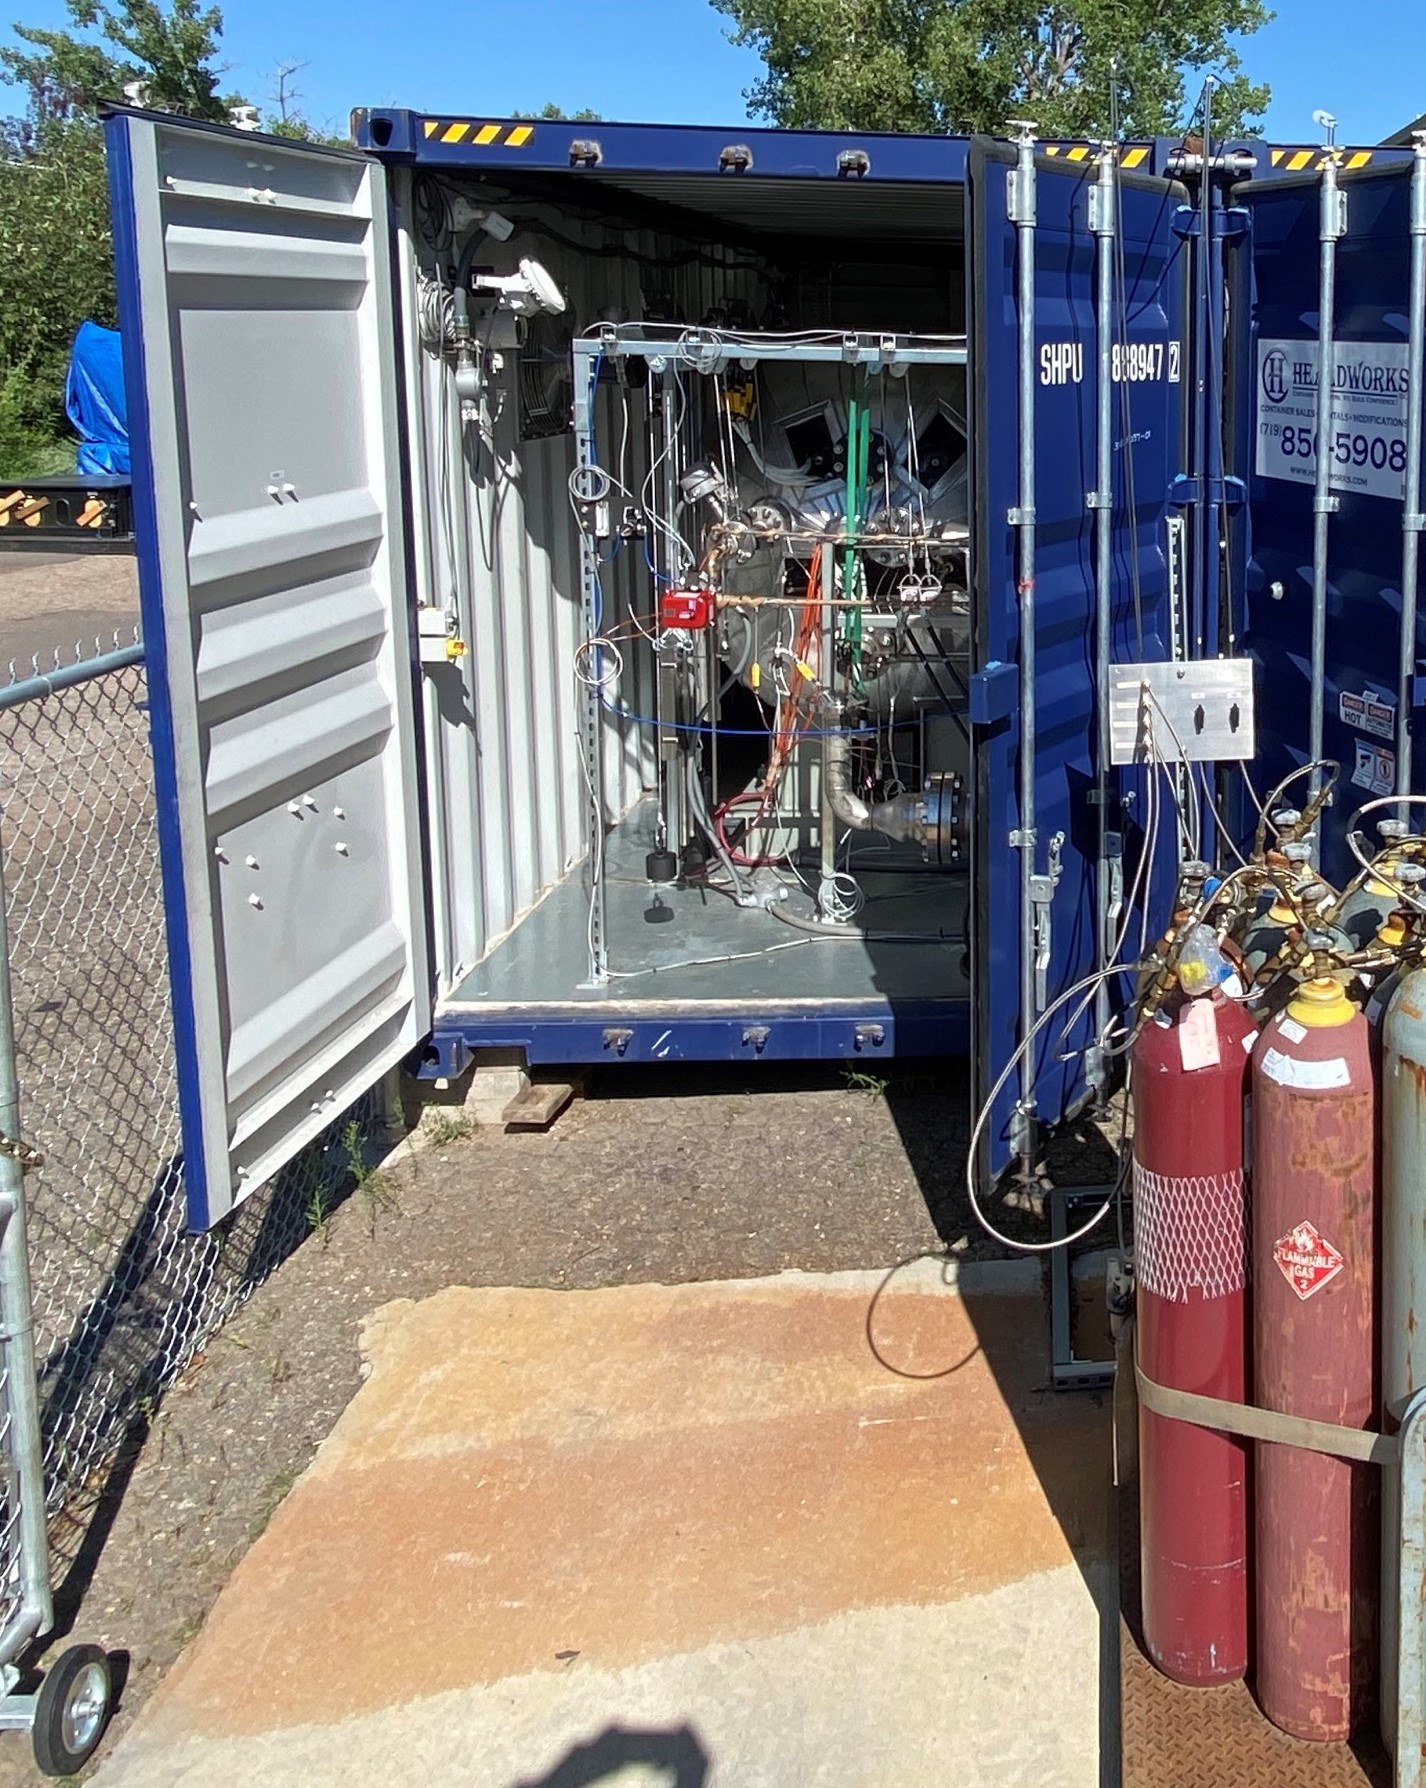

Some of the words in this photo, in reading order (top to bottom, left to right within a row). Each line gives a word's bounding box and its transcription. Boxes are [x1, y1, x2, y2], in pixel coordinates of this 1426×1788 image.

[1041, 343, 1082, 385] SHPU
[1169, 342, 1179, 381] 2
[1261, 404, 1295, 416] CONTAINER
[1295, 407, 1315, 418] SALES
[1261, 422, 1283, 437] (719)
[1344, 710, 1361, 725] HOT
[1295, 1265, 1314, 1279] GAS
[1300, 1280, 1308, 1289] 2
